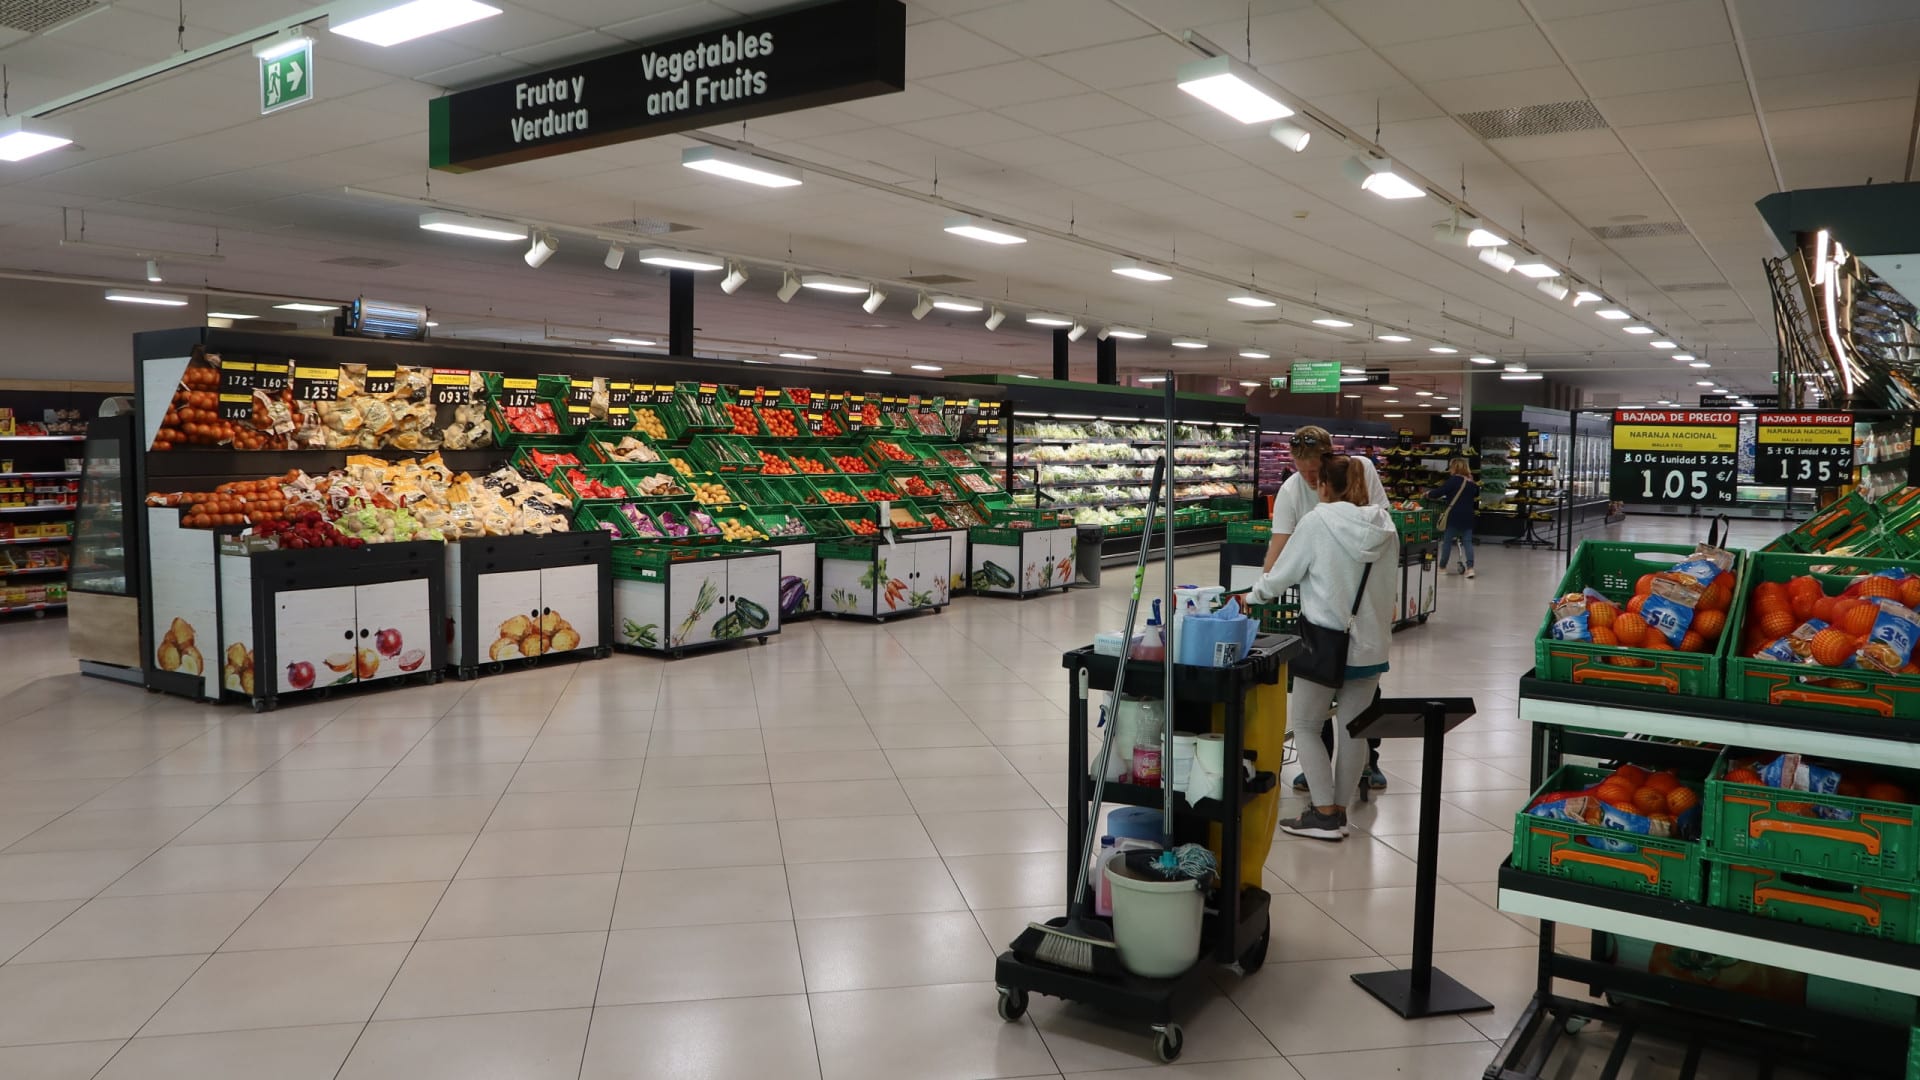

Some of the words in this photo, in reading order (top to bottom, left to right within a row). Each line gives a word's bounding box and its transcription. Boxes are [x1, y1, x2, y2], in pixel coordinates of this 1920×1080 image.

[641, 30, 774, 82] Vegetables
[516, 77, 568, 110] Fruta
[571, 75, 585, 104] y
[647, 80, 689, 116] and
[695, 67, 768, 106] Fruits
[511, 108, 589, 143] Verdura
[1622, 412, 1666, 422] BAJADA
[1670, 413, 1685, 422] DE
[1689, 413, 1732, 422] PRECIO
[1630, 431, 1670, 439] NARANJA
[1672, 432, 1717, 440] NACIONAL
[1838, 472, 1849, 480] kg
[1719, 490, 1732, 502] kg
[1562, 620, 1575, 631] KG
[1660, 613, 1676, 626] KG
[1880, 627, 1894, 642] 3
[1895, 632, 1909, 647] KG
